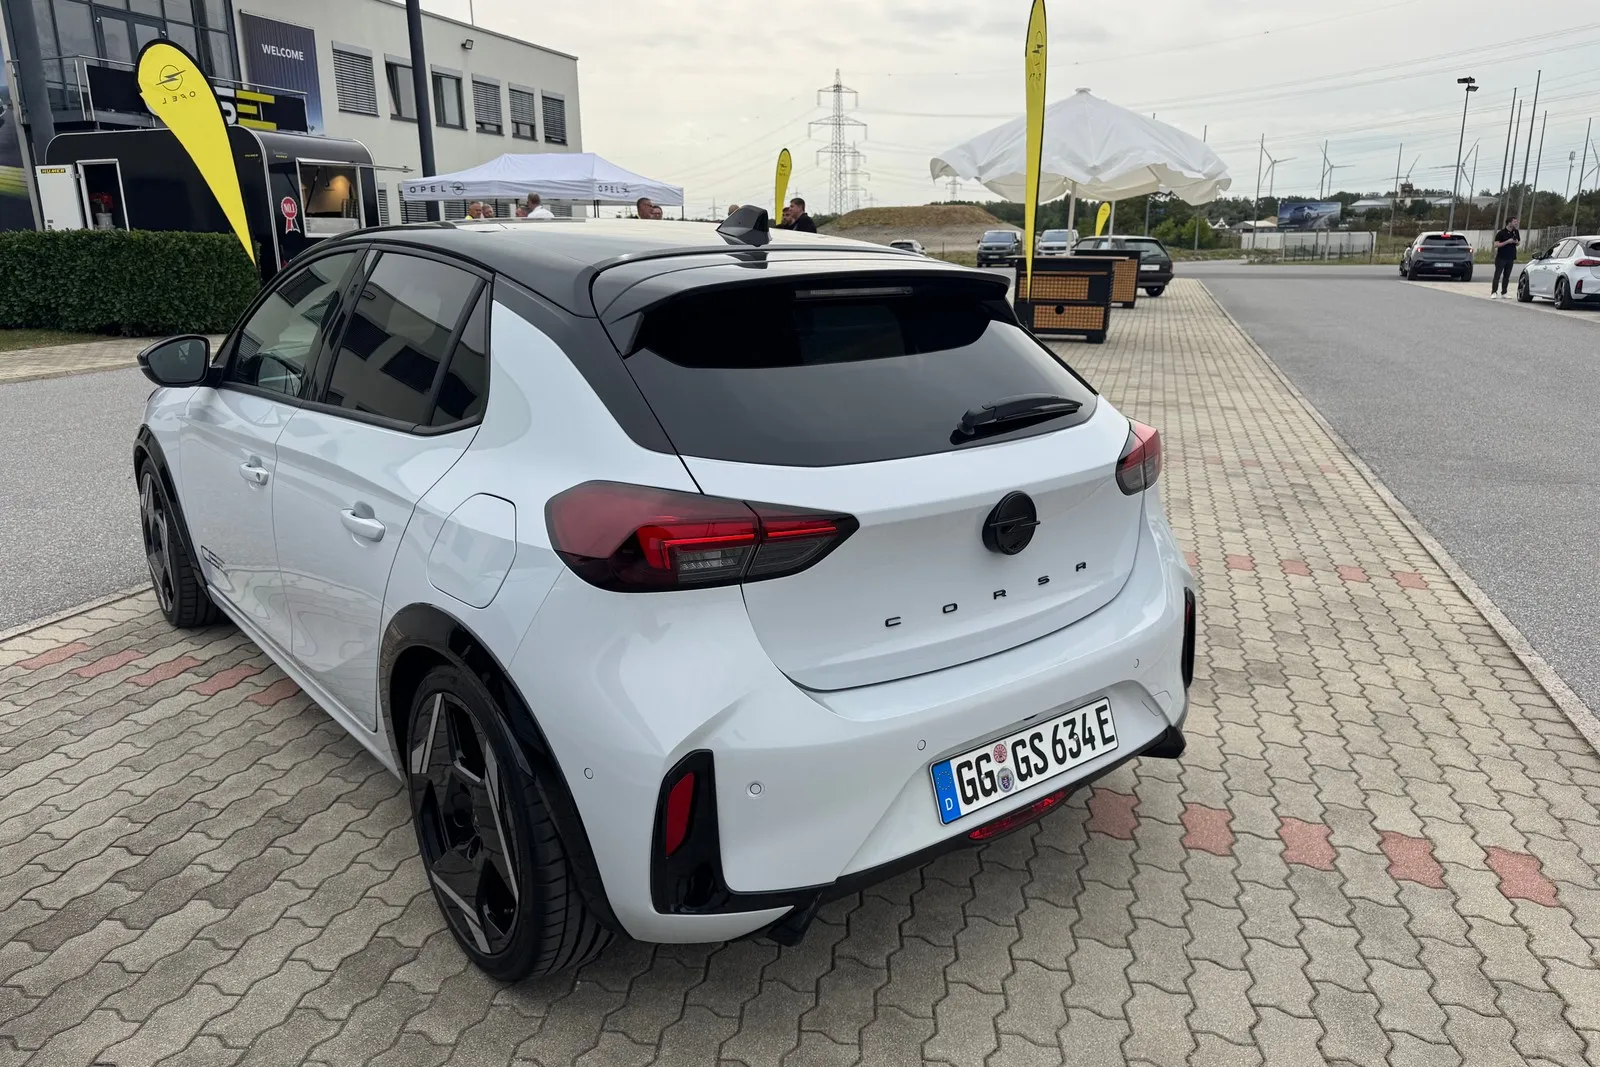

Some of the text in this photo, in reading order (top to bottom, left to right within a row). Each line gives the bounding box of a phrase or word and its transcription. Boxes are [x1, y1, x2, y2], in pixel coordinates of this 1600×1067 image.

[261, 43, 304, 61] WELCOME
[409, 185, 446, 194] OPEL
[598, 184, 620, 193] OPEL
[884, 561, 1087, 628] CORSA
[945, 797, 954, 811] D
